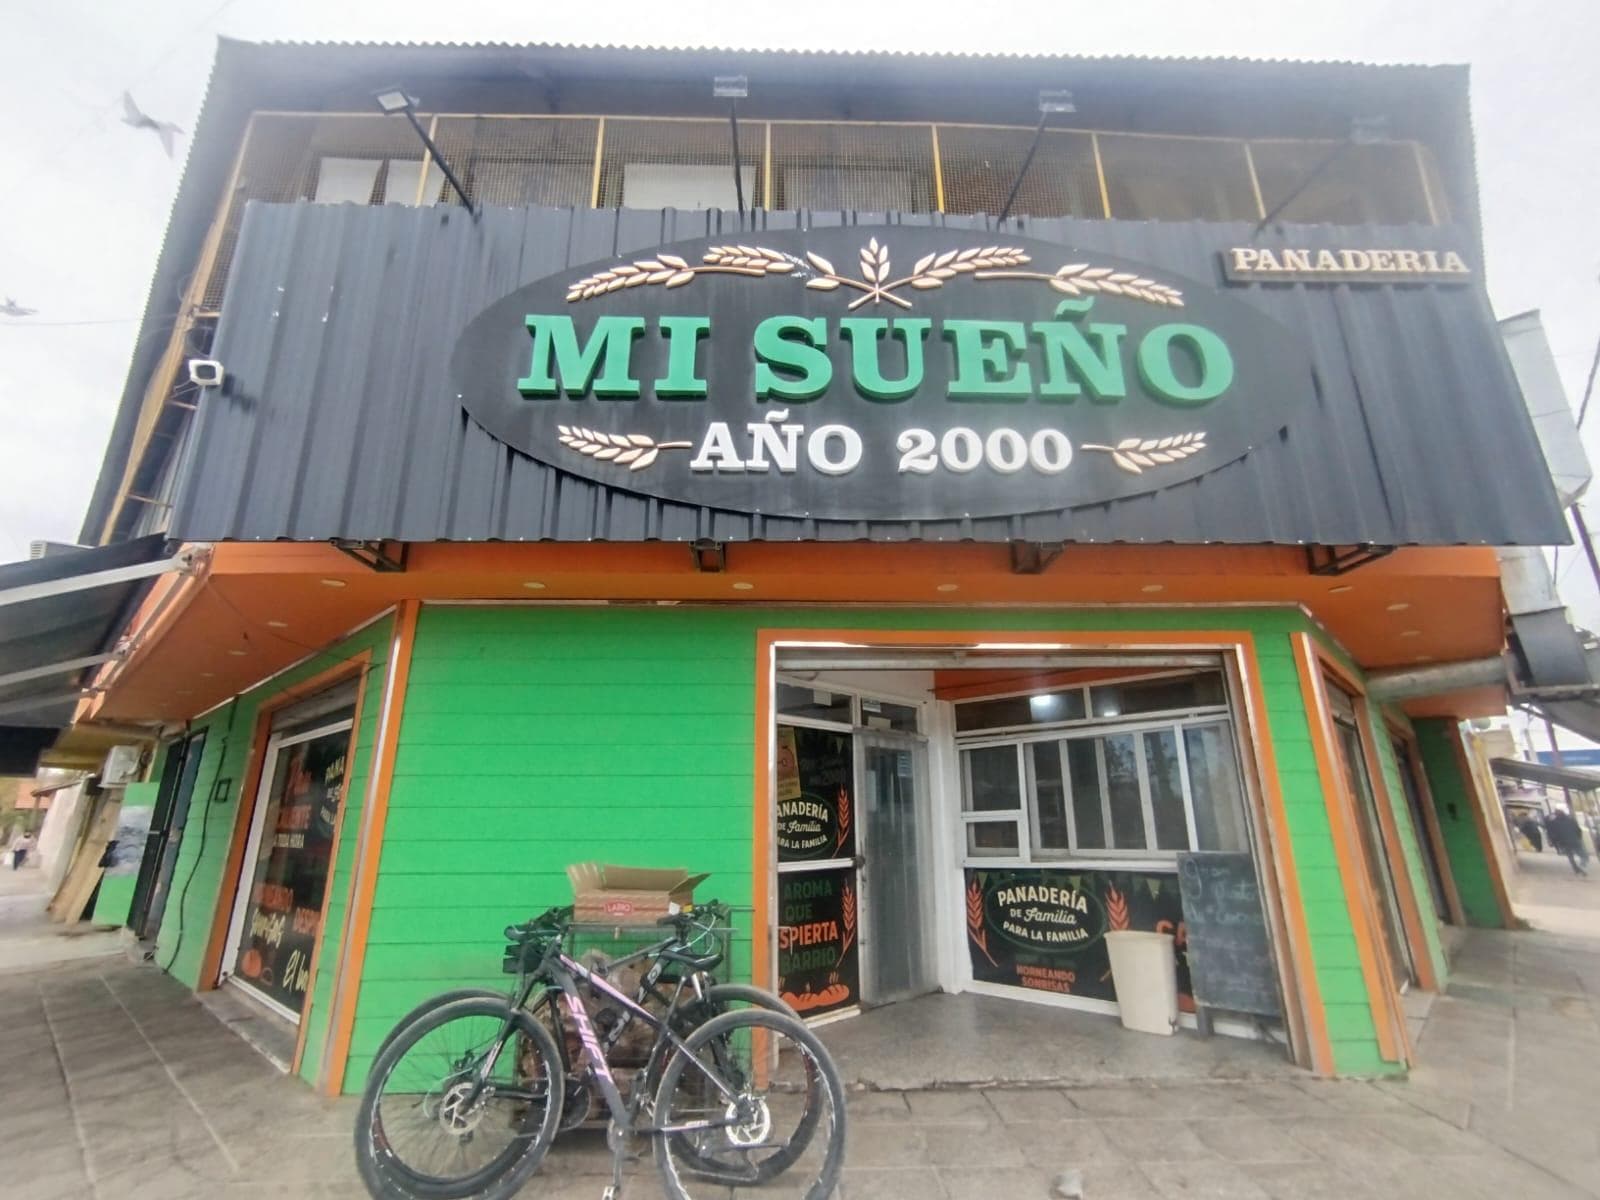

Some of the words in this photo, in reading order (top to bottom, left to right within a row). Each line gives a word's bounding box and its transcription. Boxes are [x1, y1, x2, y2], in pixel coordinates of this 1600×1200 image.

[1232, 248, 1471, 273] PANADERIA
[517, 314, 711, 399] MI
[753, 296, 1234, 405] SUEÑO
[690, 409, 863, 475] AÑO
[897, 427, 1073, 475] 2000
[791, 840, 800, 849] LA
[801, 834, 828, 849] FAMILIA
[783, 880, 832, 899] AROMA
[998, 886, 1088, 914] PANADERÍA
[785, 903, 813, 921] QUE
[1010, 908, 1022, 918] DE
[1024, 907, 1077, 925] Familia
[778, 921, 839, 949] SPIERTA
[1003, 921, 1028, 938] PARA
[1031, 929, 1043, 941] LA
[1046, 928, 1089, 942] FAMILIA
[780, 946, 836, 975] BARRIO
[564, 992, 614, 1085] SHIFT
